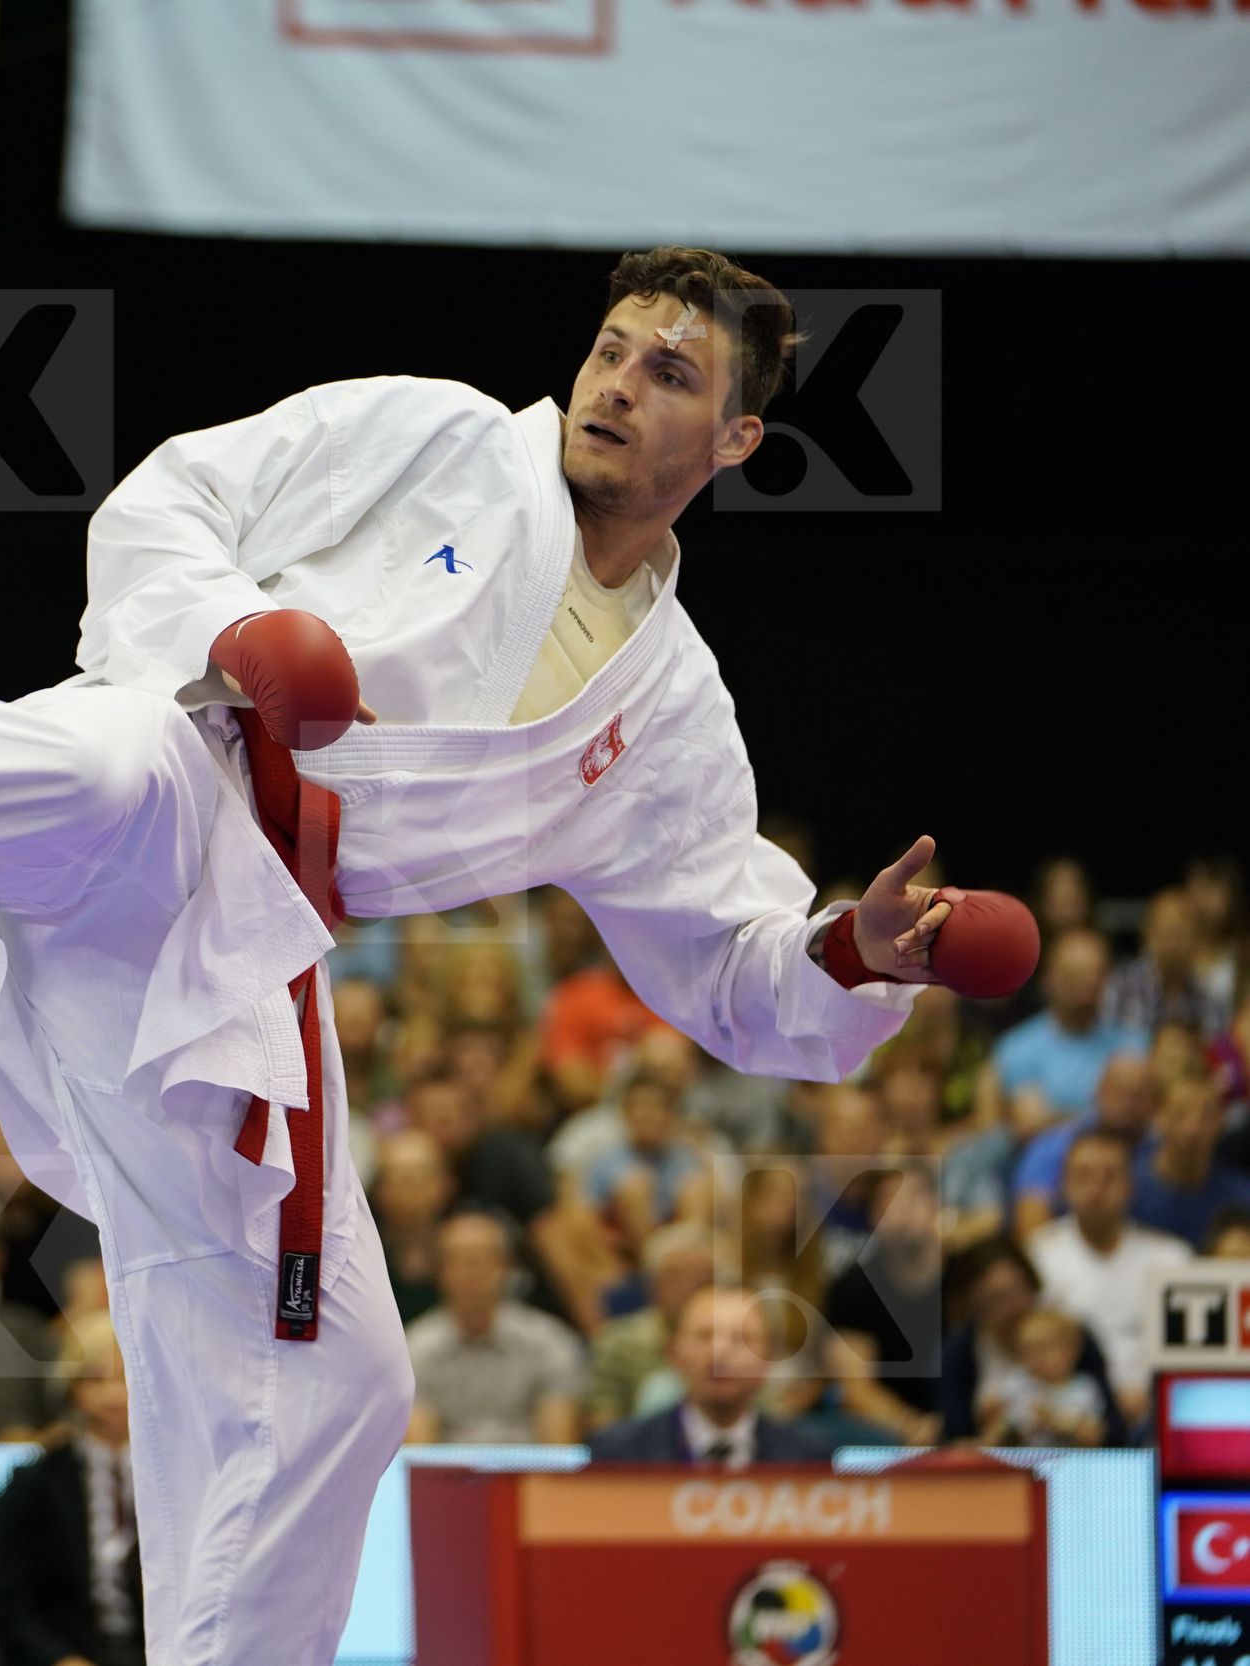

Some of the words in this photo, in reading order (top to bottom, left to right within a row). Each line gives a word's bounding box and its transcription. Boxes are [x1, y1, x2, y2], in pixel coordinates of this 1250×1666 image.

[568, 606, 594, 643] APPROVED
[286, 1257, 305, 1312] Arawaza
[671, 1480, 892, 1537] COACH
